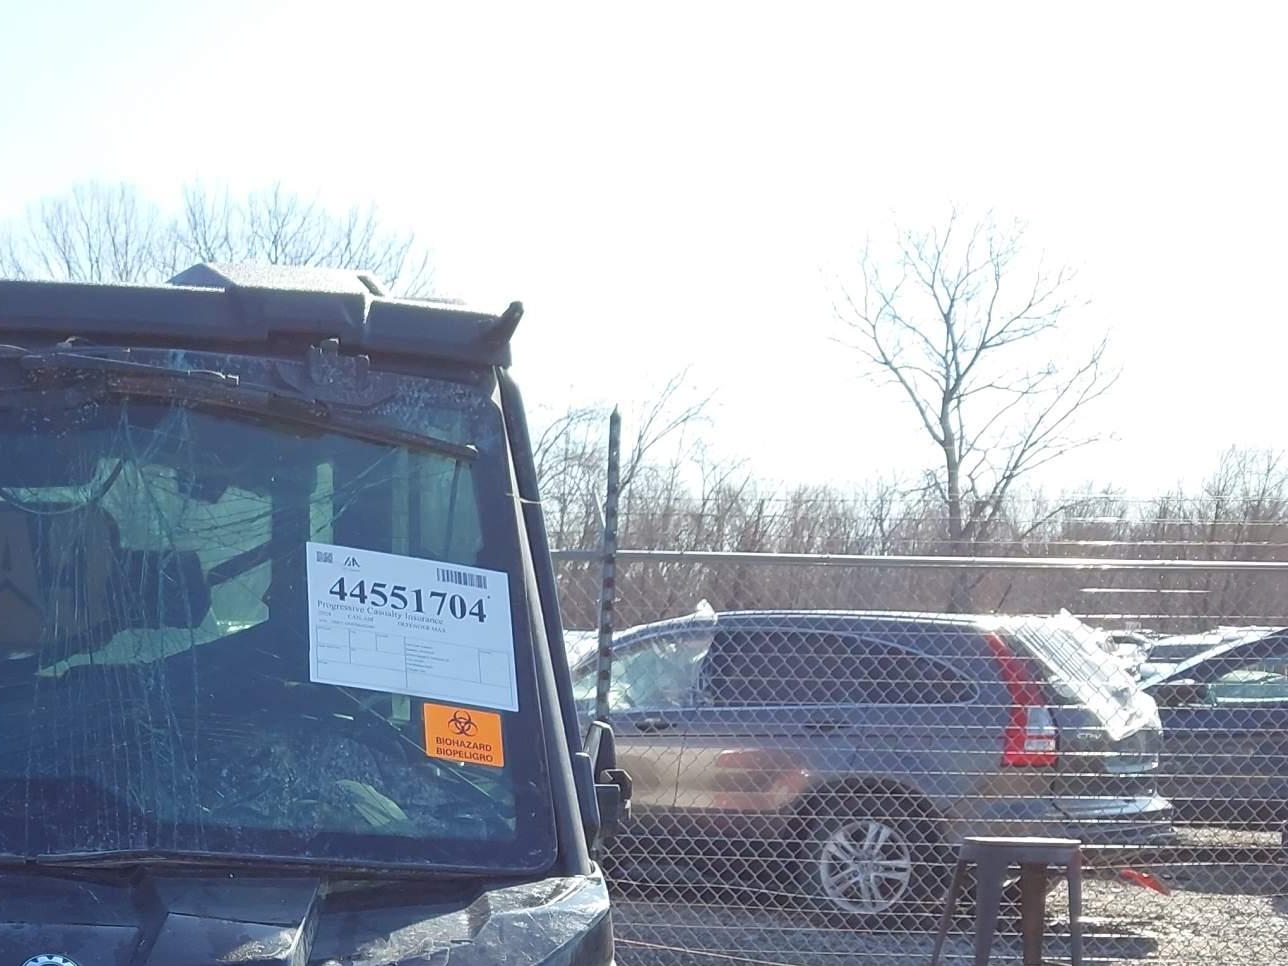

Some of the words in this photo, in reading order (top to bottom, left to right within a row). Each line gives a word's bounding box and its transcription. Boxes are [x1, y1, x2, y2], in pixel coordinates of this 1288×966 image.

[329, 577, 487, 623] 44551704
[317, 599, 364, 614] Progressive
[367, 606, 402, 620] Casualty
[405, 611, 443, 626] Insurance
[436, 737, 492, 752] BIOHAZARD
[436, 747, 493, 762] BIOPELIGRO
